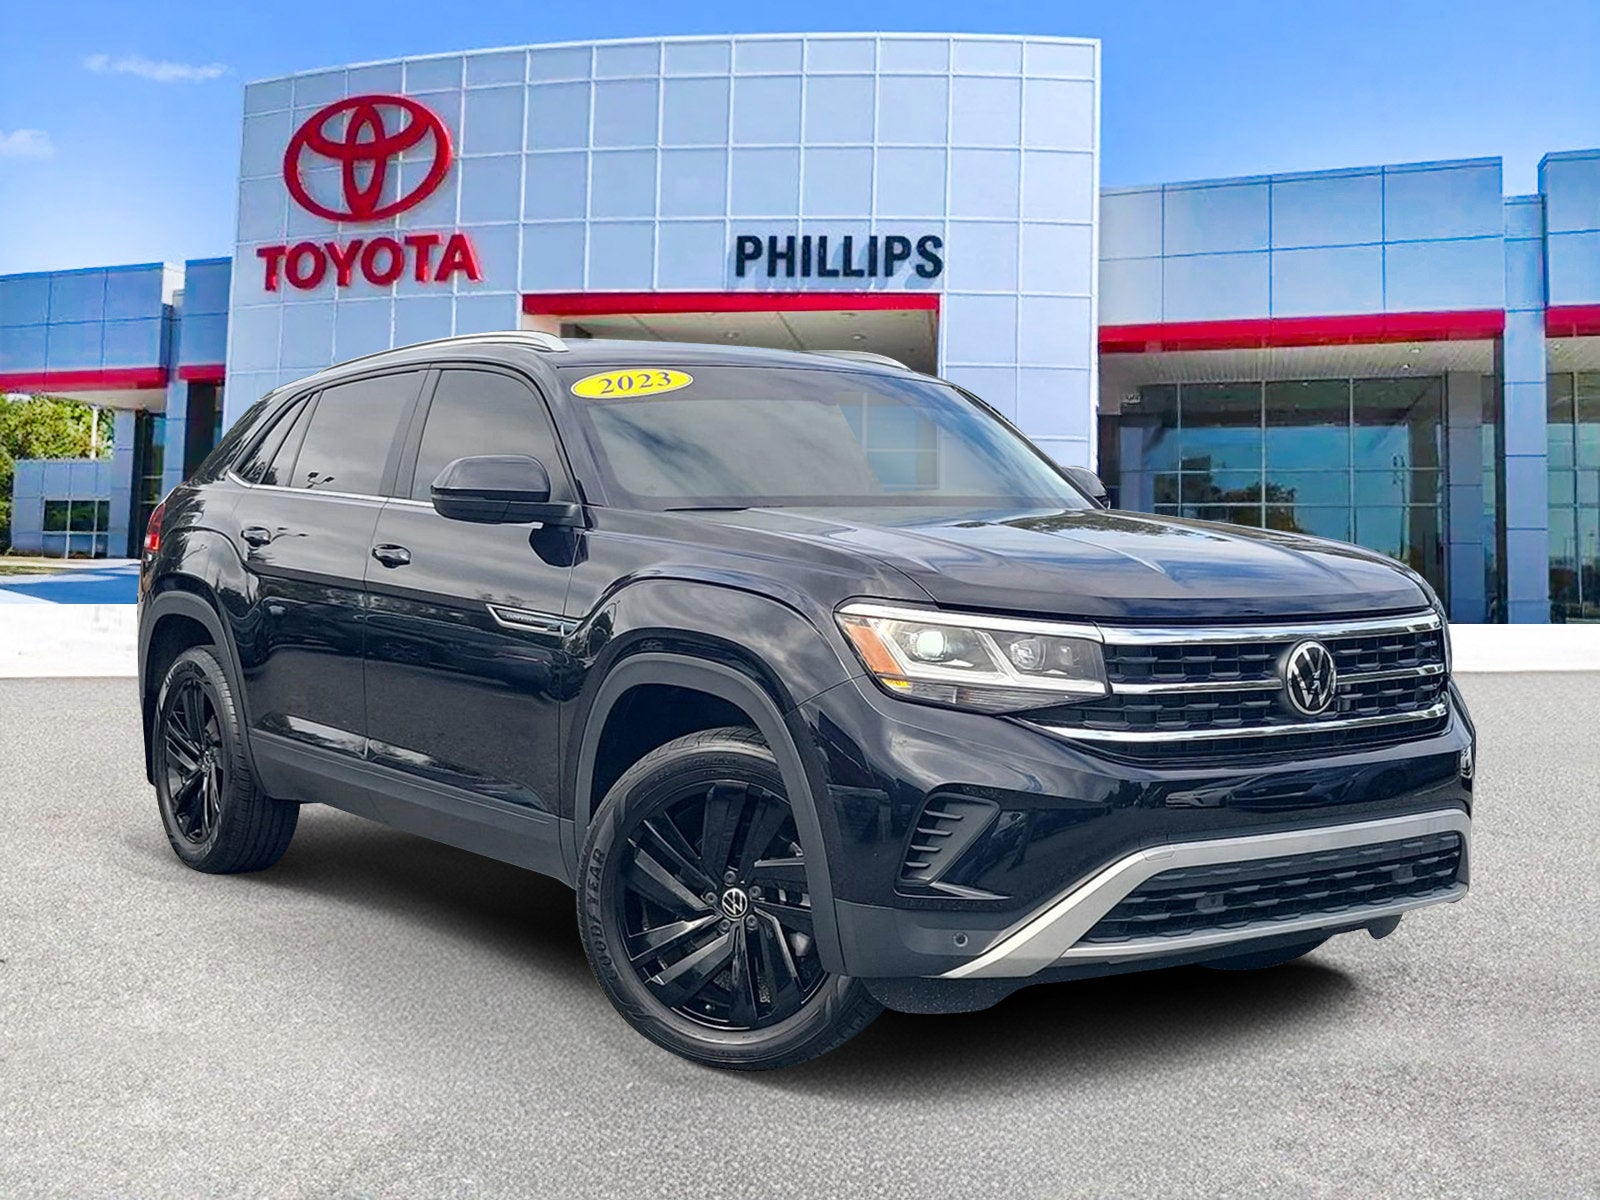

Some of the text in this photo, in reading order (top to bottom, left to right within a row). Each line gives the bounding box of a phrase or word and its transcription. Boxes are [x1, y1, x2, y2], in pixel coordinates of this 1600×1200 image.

[257, 233, 483, 292] TOYOTA
[736, 235, 944, 279] PHILLIPS
[598, 371, 672, 394] 2023
